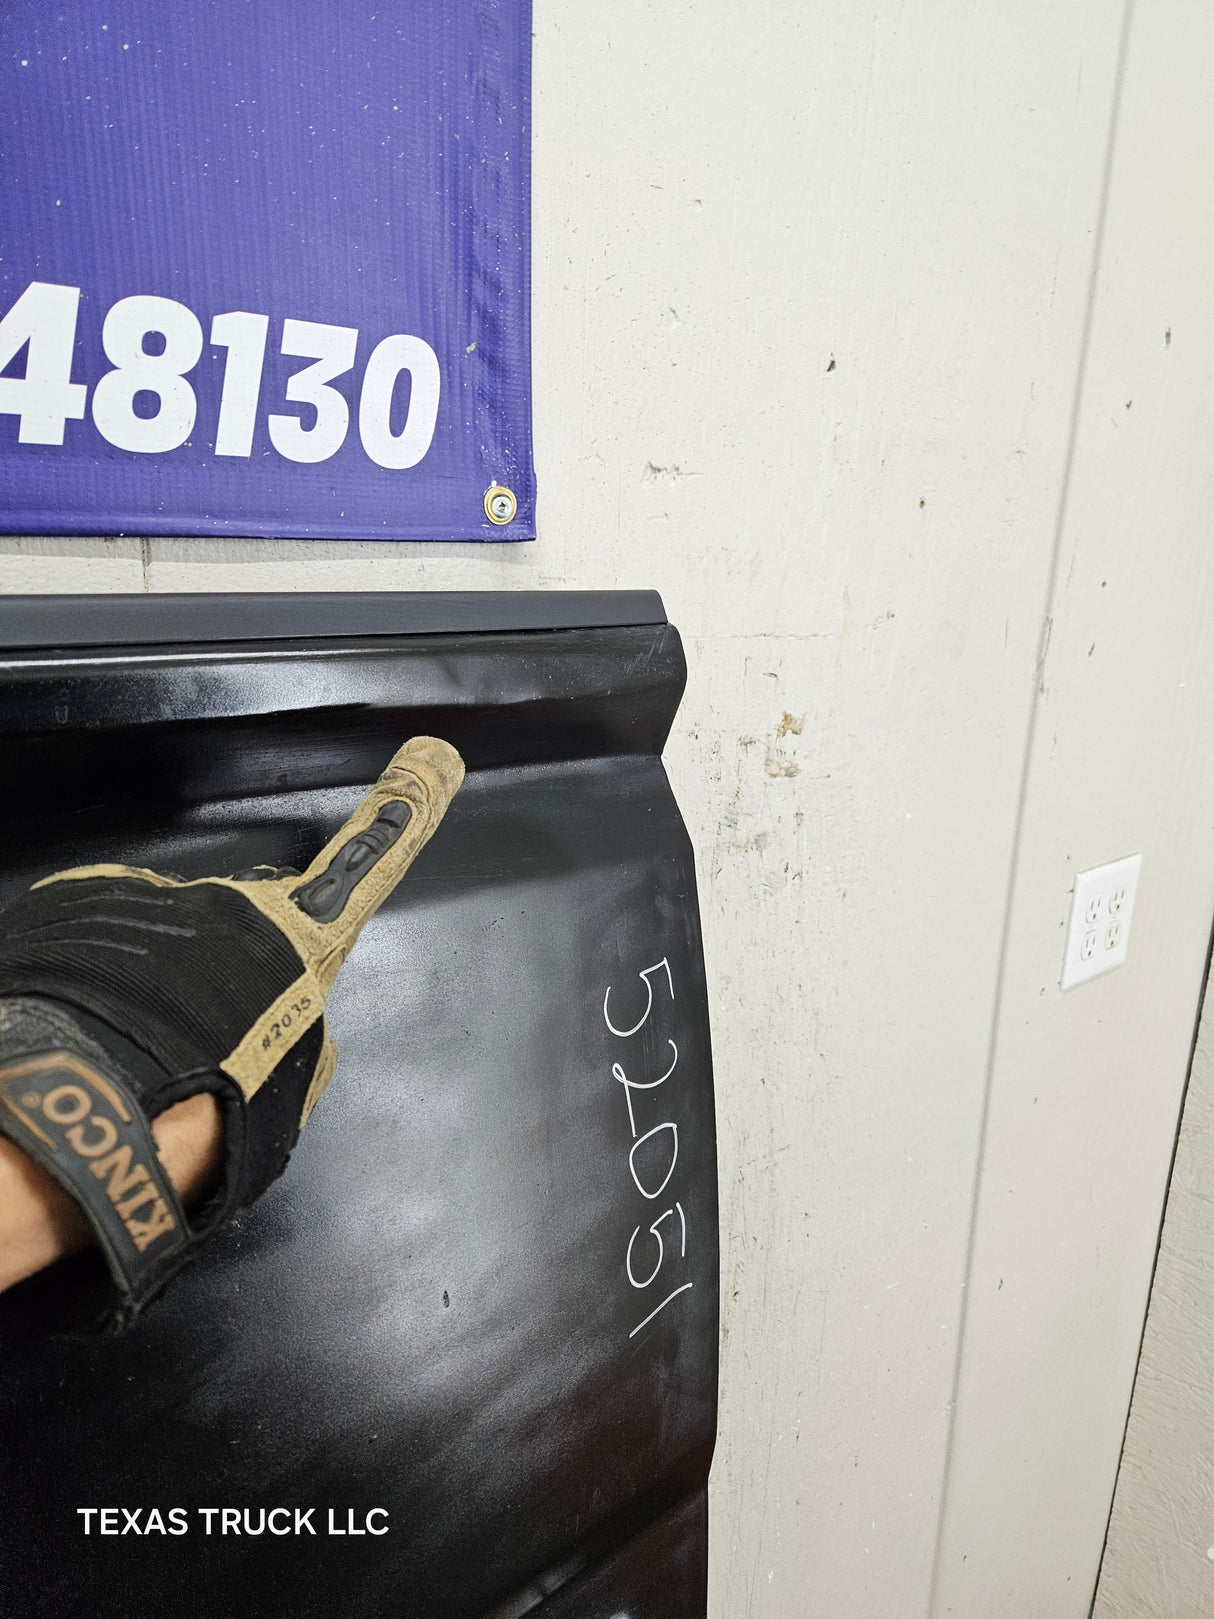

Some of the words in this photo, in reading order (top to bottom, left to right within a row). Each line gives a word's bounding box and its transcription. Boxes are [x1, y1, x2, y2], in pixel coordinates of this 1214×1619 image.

[0, 281, 441, 470] 48130
[261, 996, 313, 1052] #2035
[41, 1084, 176, 1253] KINCO
[603, 957, 693, 1339] 52051
